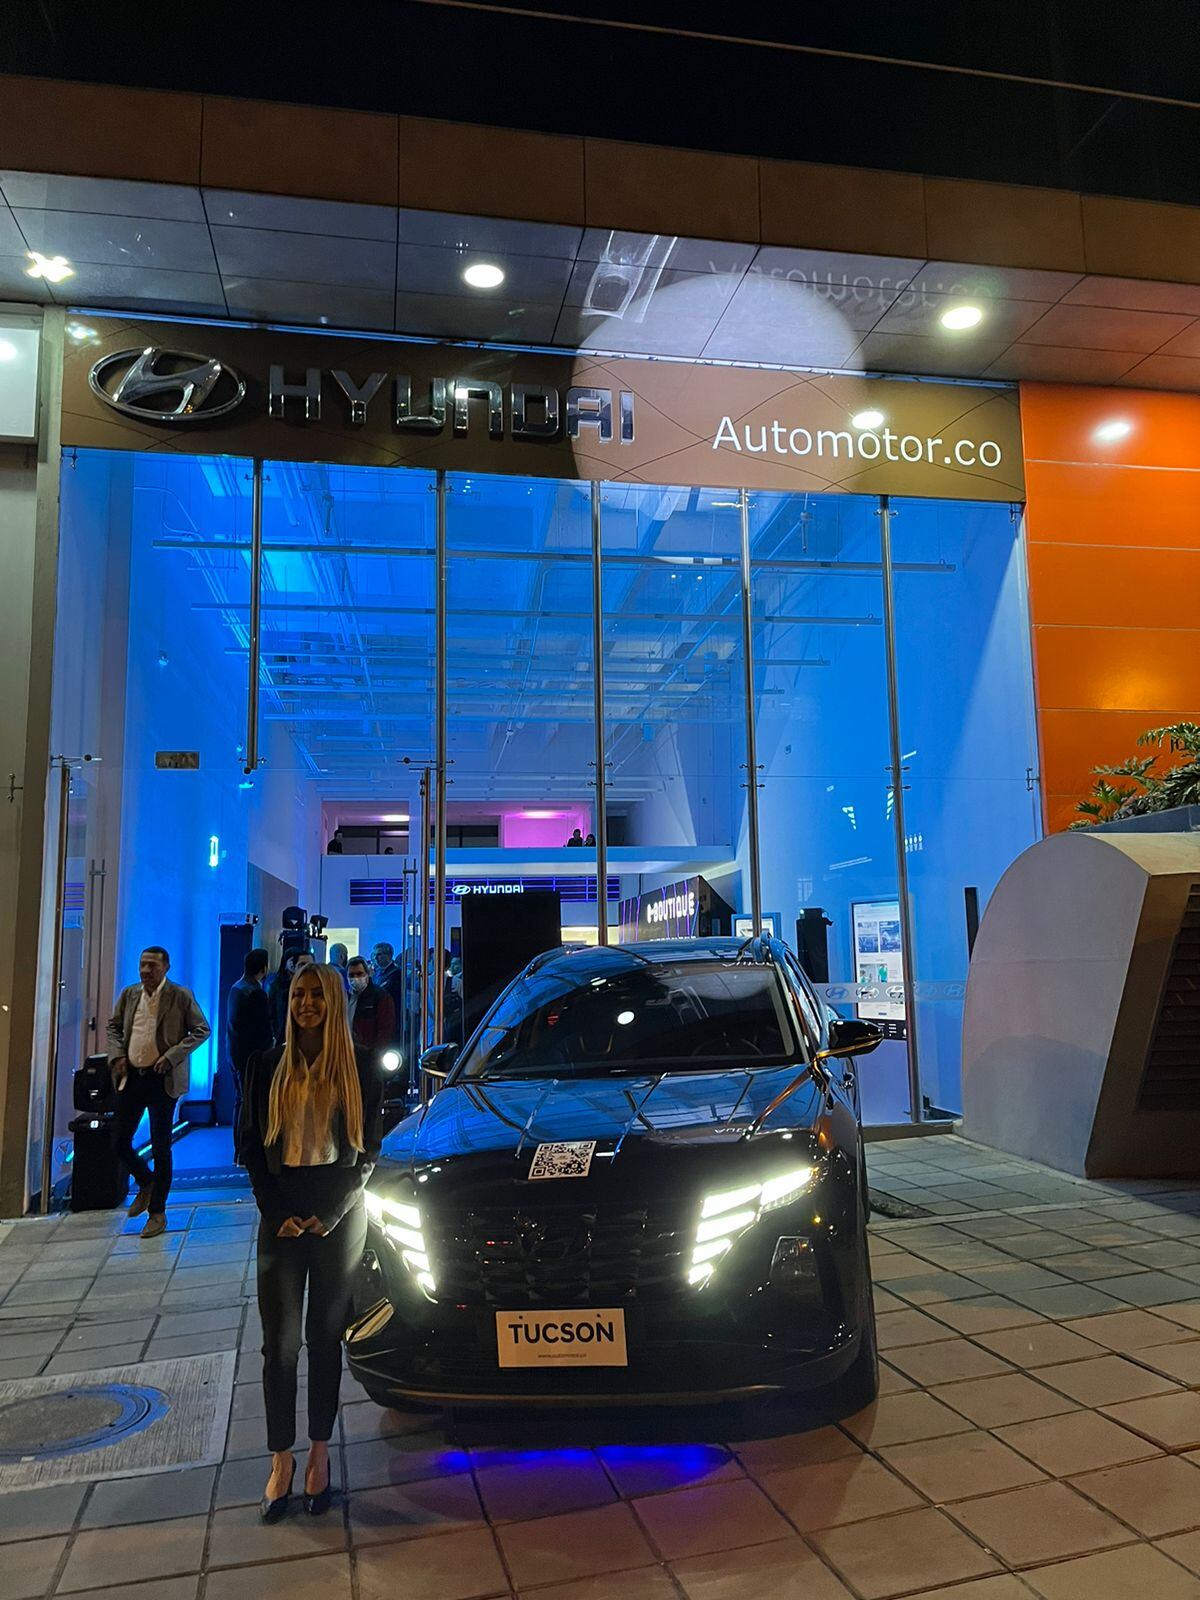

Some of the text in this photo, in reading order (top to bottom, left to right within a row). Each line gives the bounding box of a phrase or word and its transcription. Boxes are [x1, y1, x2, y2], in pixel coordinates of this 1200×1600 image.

[267, 364, 636, 445] HYUNDAI
[711, 415, 1003, 468] Automotor.co
[473, 885, 524, 895] HYUNDAI
[508, 1322, 615, 1344] TUCSON
